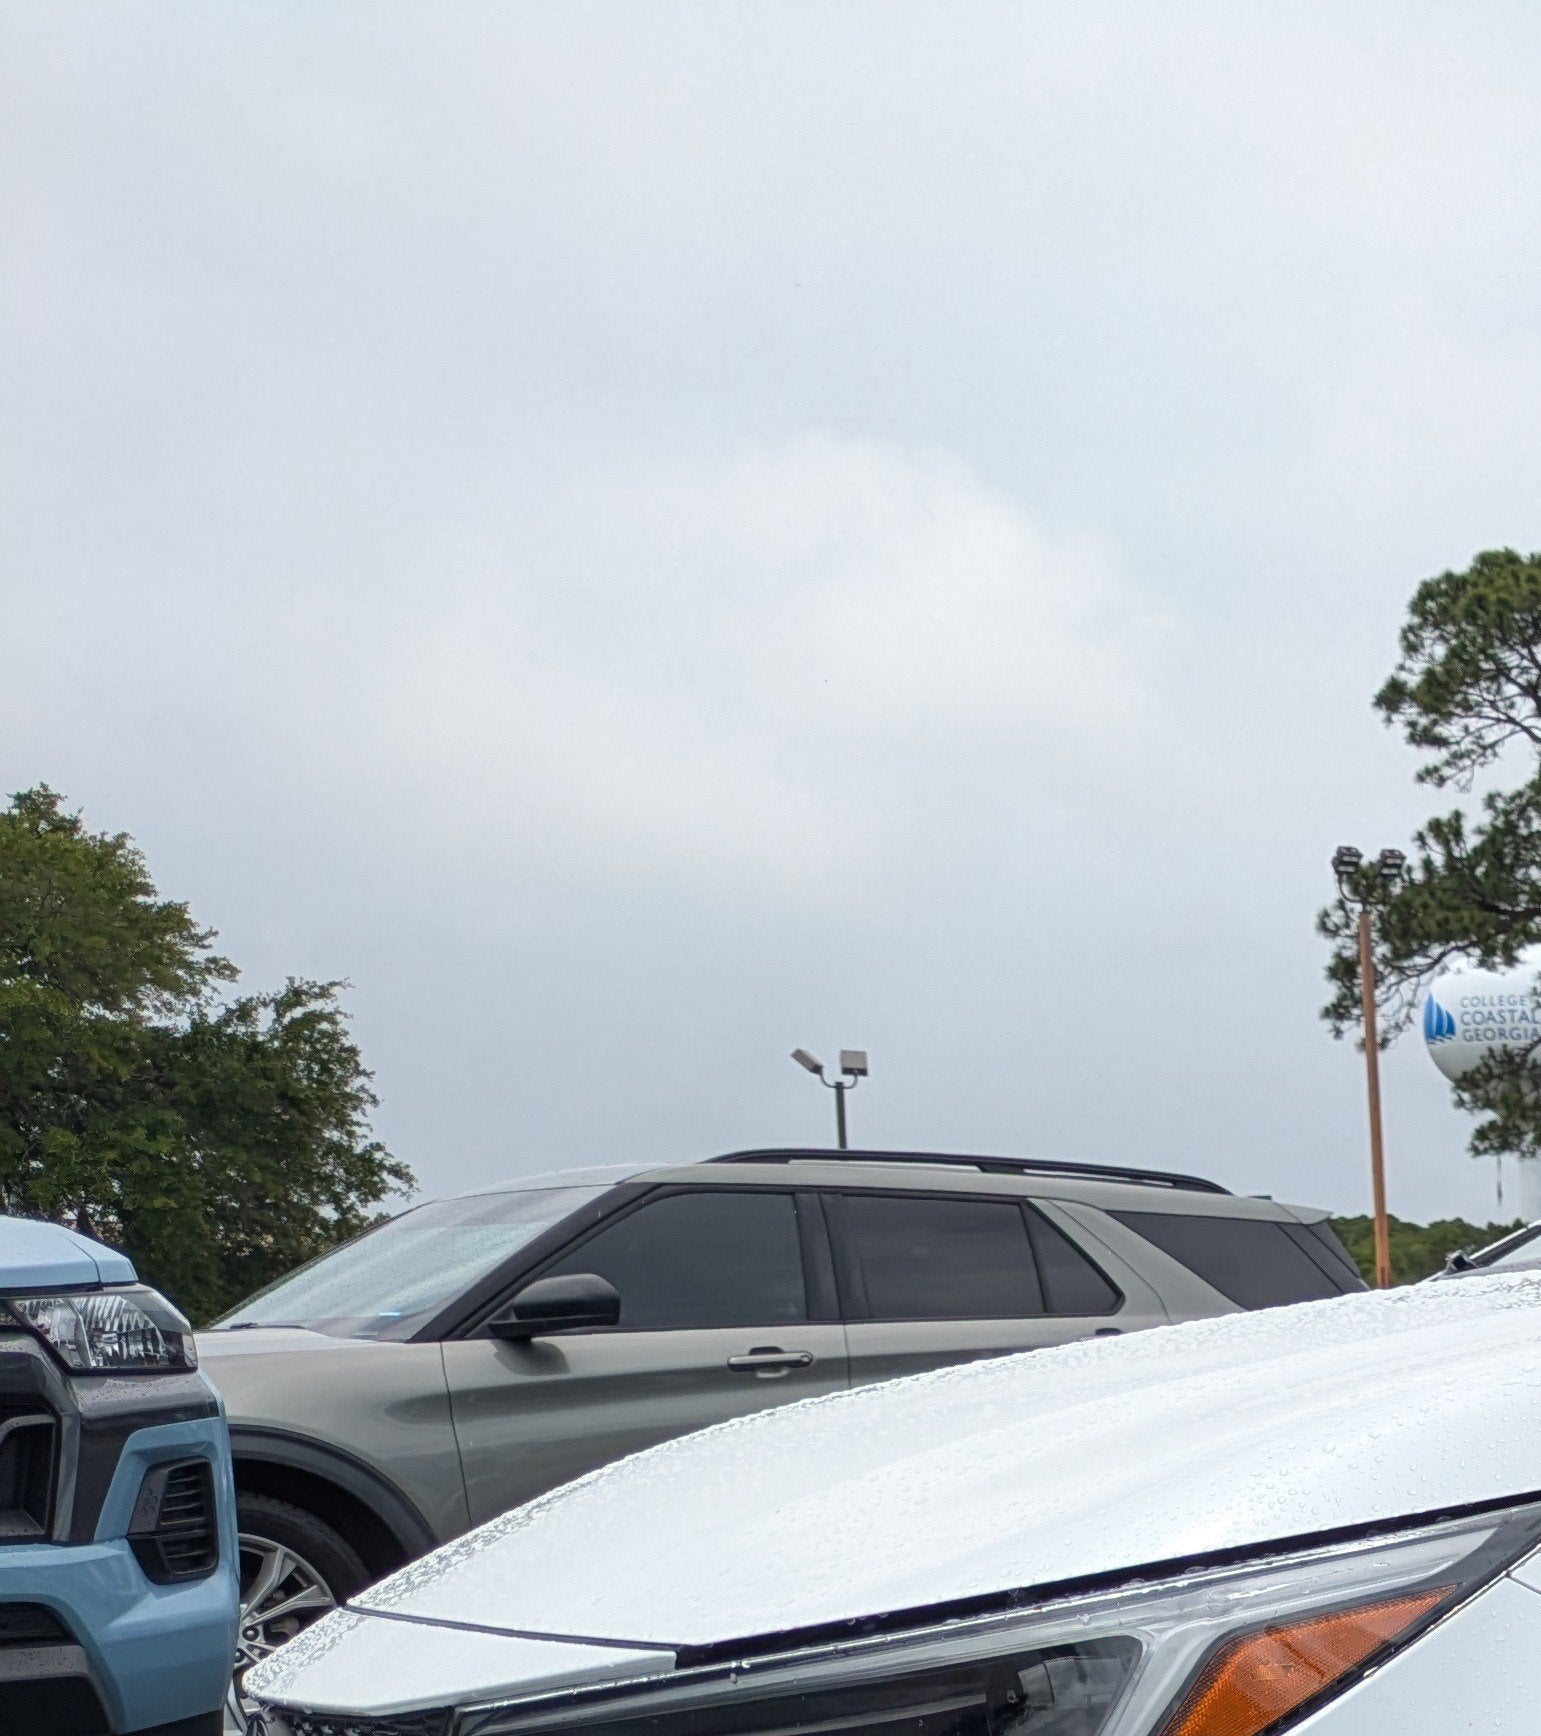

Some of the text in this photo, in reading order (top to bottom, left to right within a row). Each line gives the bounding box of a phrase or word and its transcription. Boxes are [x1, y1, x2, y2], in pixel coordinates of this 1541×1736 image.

[1461, 995, 1527, 1008] COLLEGE
[1461, 1009, 1540, 1026] COASTAL
[1462, 1026, 1541, 1042] GEORGIA
